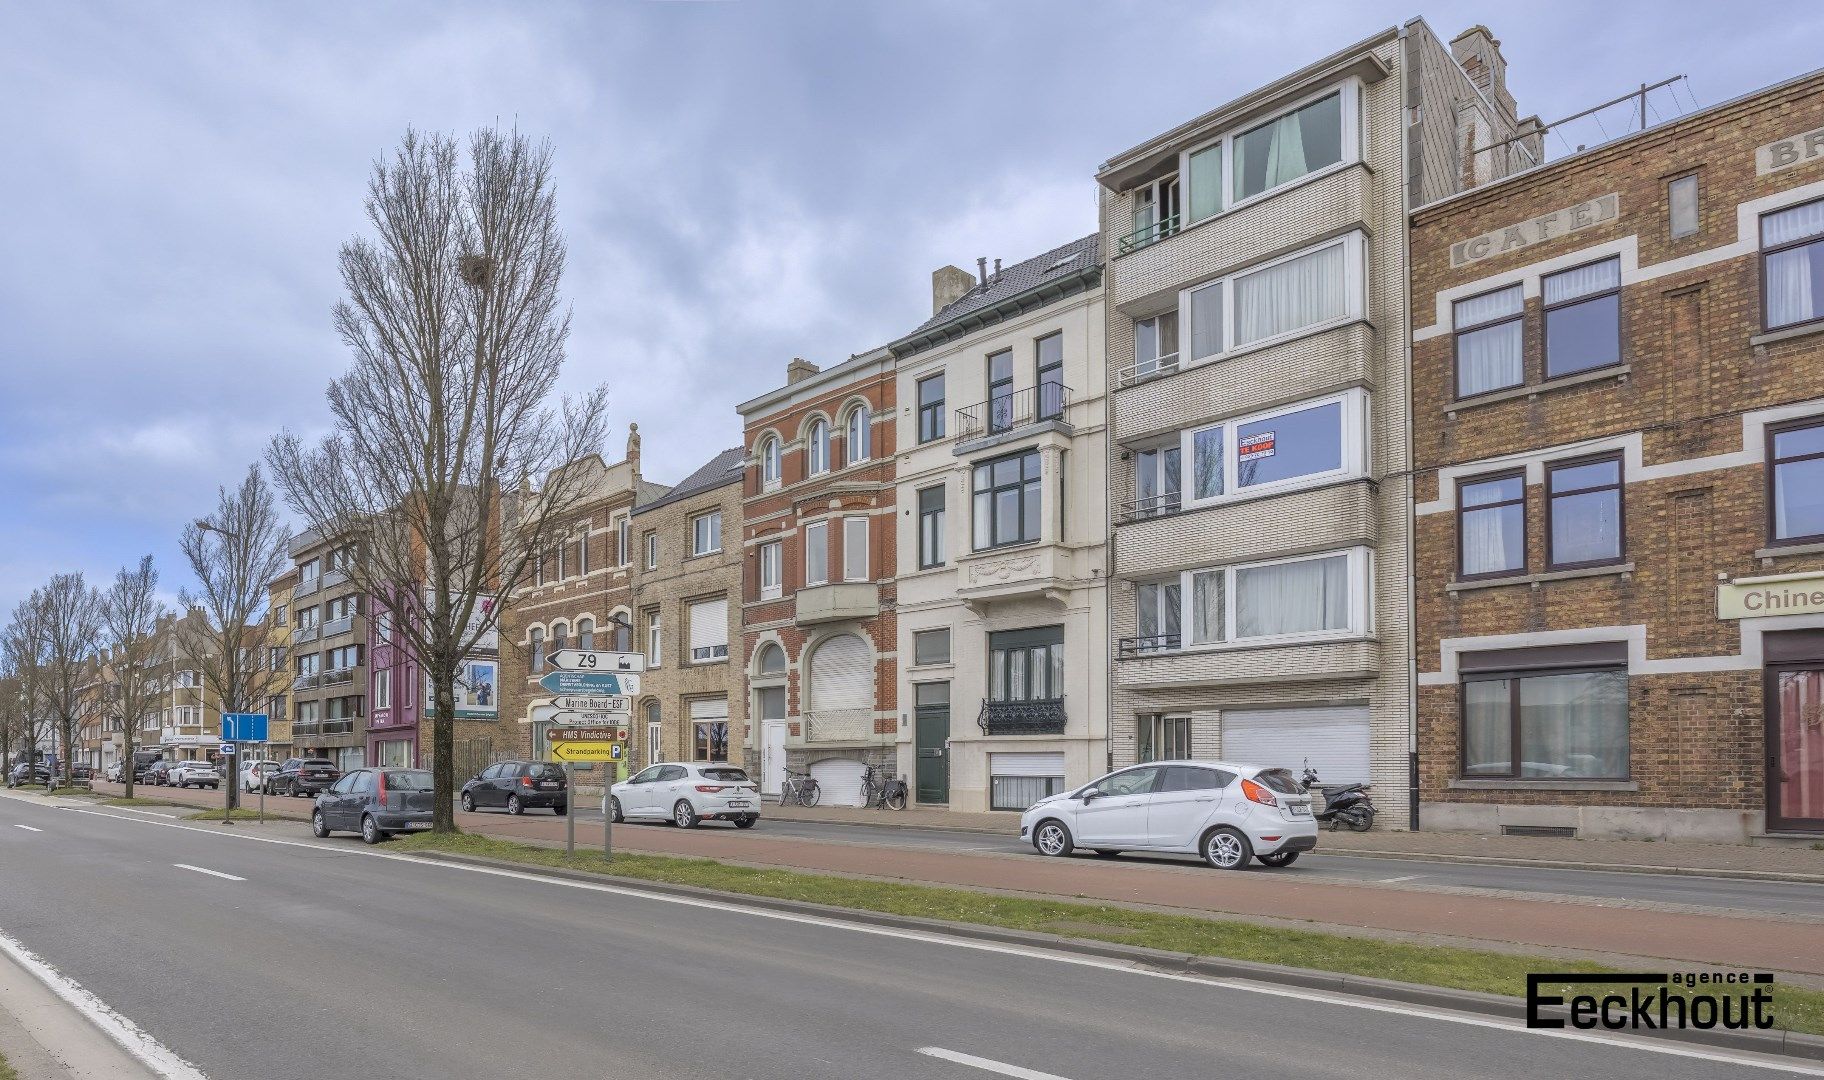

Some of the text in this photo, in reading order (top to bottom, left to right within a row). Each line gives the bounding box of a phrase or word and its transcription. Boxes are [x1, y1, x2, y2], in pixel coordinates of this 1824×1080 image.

[1467, 203, 1593, 259] CAFE
[1252, 441, 1274, 452] KOOP
[1743, 589, 1824, 611] Chine
[578, 654, 597, 668] Z9
[565, 697, 588, 708] Marine
[562, 730, 612, 739] HMS Vindictive
[566, 747, 610, 756] Strandparking
